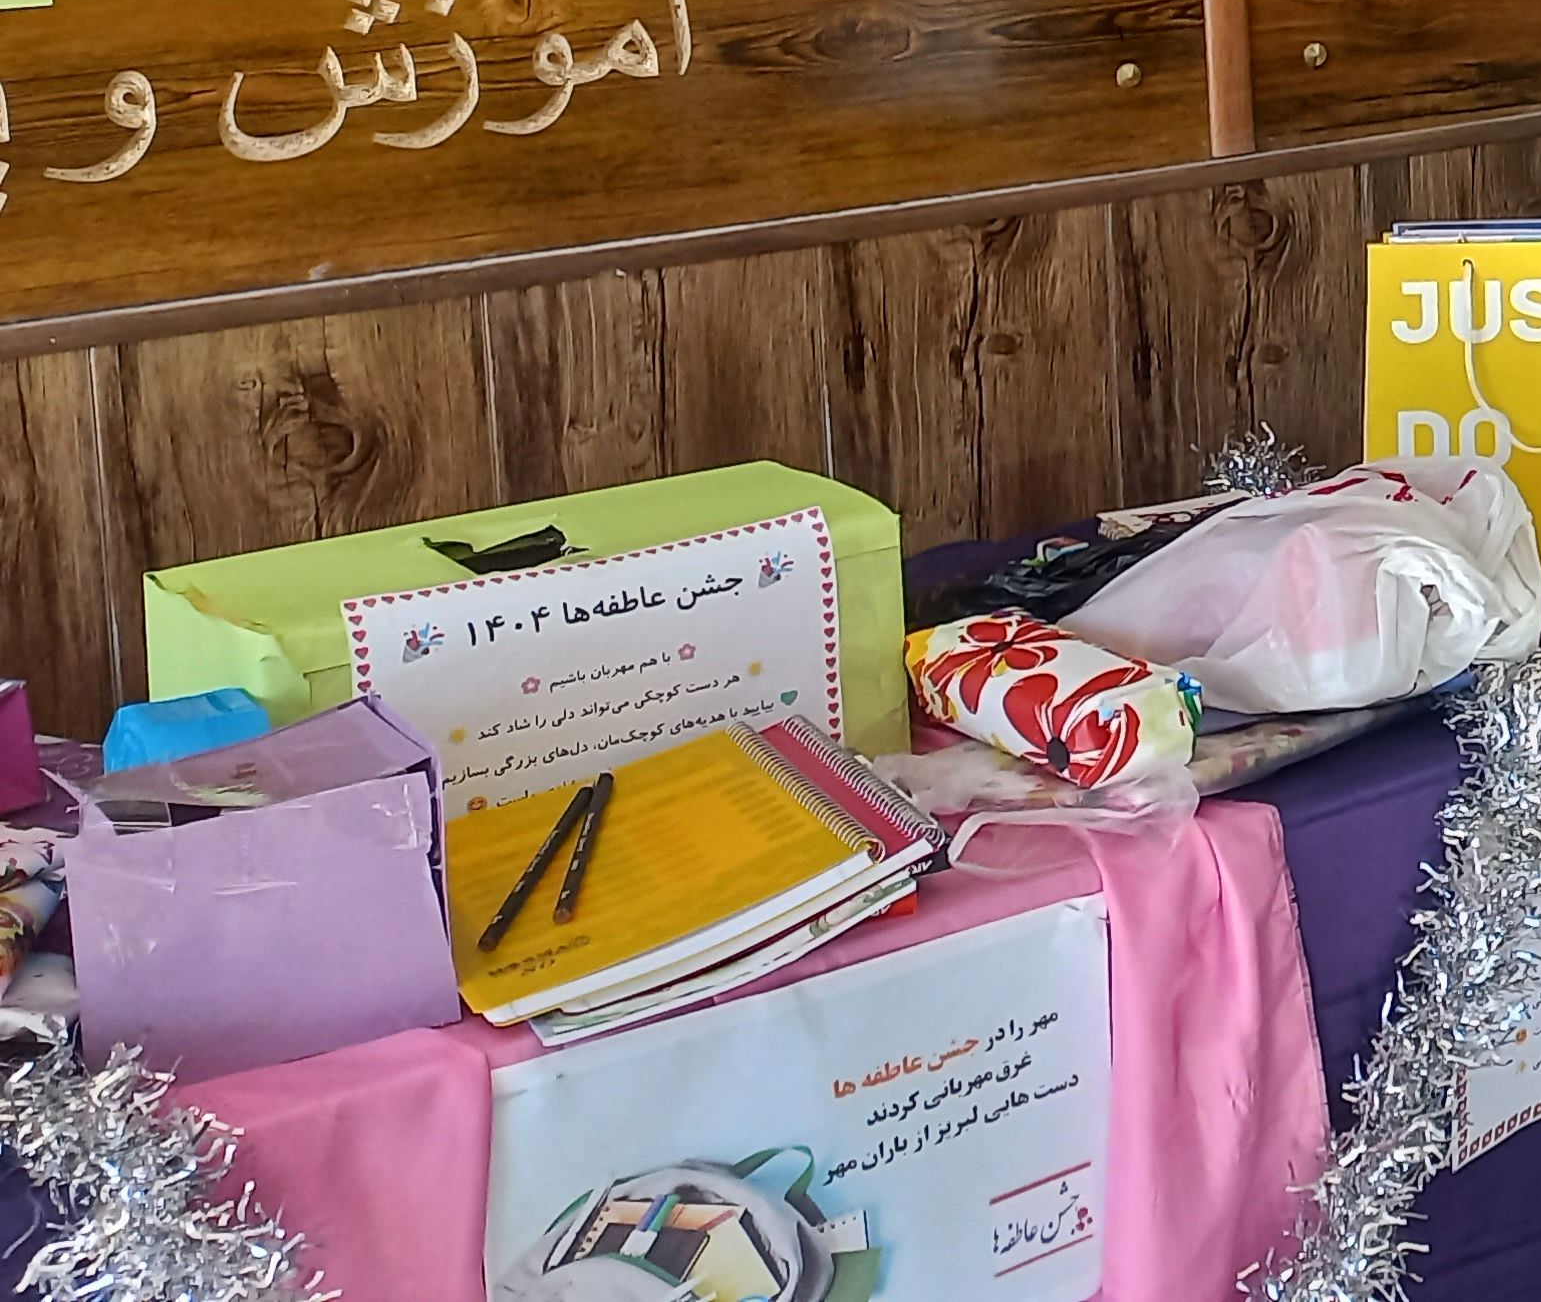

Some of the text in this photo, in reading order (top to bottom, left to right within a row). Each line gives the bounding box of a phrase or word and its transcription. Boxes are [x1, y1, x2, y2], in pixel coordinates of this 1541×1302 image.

[42, 70, 156, 184] و
[1397, 408, 1513, 468] DO
[676, 573, 743, 610] جشن
[466, 606, 550, 647] ۱۴۰۴
[549, 651, 671, 692] با هم مهربان باشیم
[725, 673, 741, 690] هر
[686, 677, 719, 693] دست
[634, 685, 681, 710] کوچکی
[742, 700, 775, 717] بیایید
[535, 714, 547, 728] را
[552, 708, 575, 729] دلی
[729, 707, 738, 719] با
[477, 723, 501, 741] کند
[506, 719, 531, 734] شاد
[442, 766, 489, 790] بسازیم
[494, 754, 538, 778] بزرگی
[832, 1010, 1058, 1099] مهر را در جشن عاطفه ها
[867, 1050, 1032, 1126] غرق مهربانی کردند
[823, 1072, 1079, 1186] دست هایی لبریز از باران مهر
